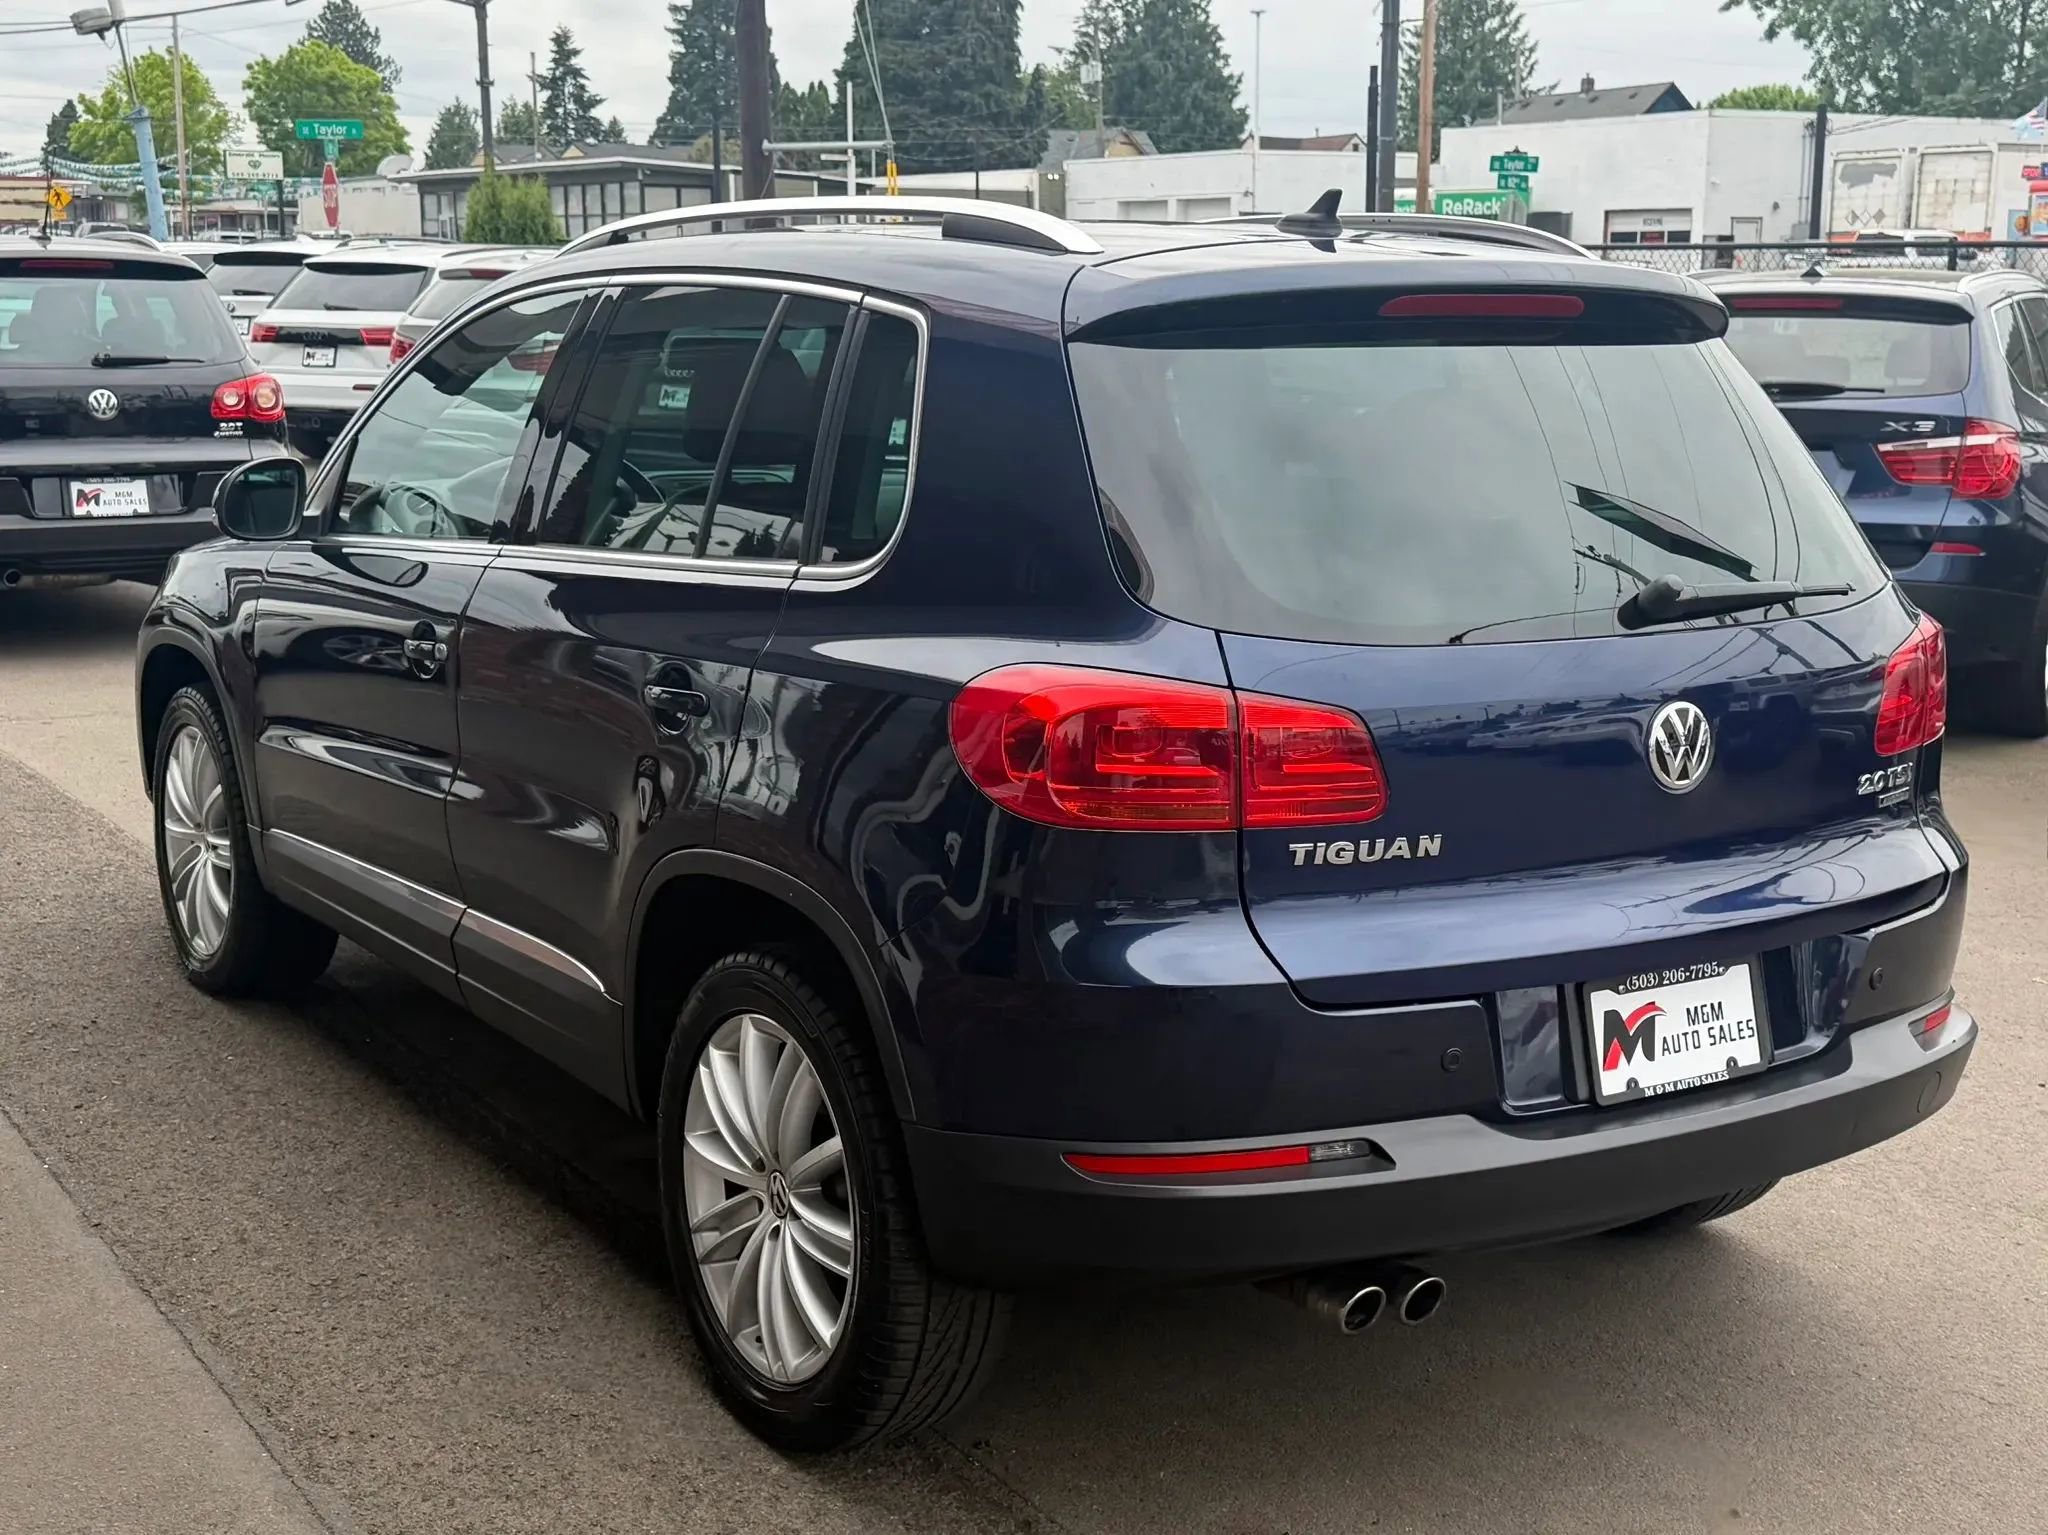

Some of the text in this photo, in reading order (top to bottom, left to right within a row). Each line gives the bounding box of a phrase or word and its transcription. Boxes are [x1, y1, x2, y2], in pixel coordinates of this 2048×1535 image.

[313, 124, 347, 137] Taylor
[1441, 197, 1501, 215] ReRack
[1880, 420, 1937, 432] X3
[124, 498, 147, 506] SALES
[1289, 834, 1443, 866] TIGUAN
[1626, 961, 1719, 991] (503) 206-7795
[1661, 1019, 1756, 1057] AUTO SALES
[1676, 1077, 1701, 1091] AUTO
[1701, 1071, 1729, 1086] SALES
